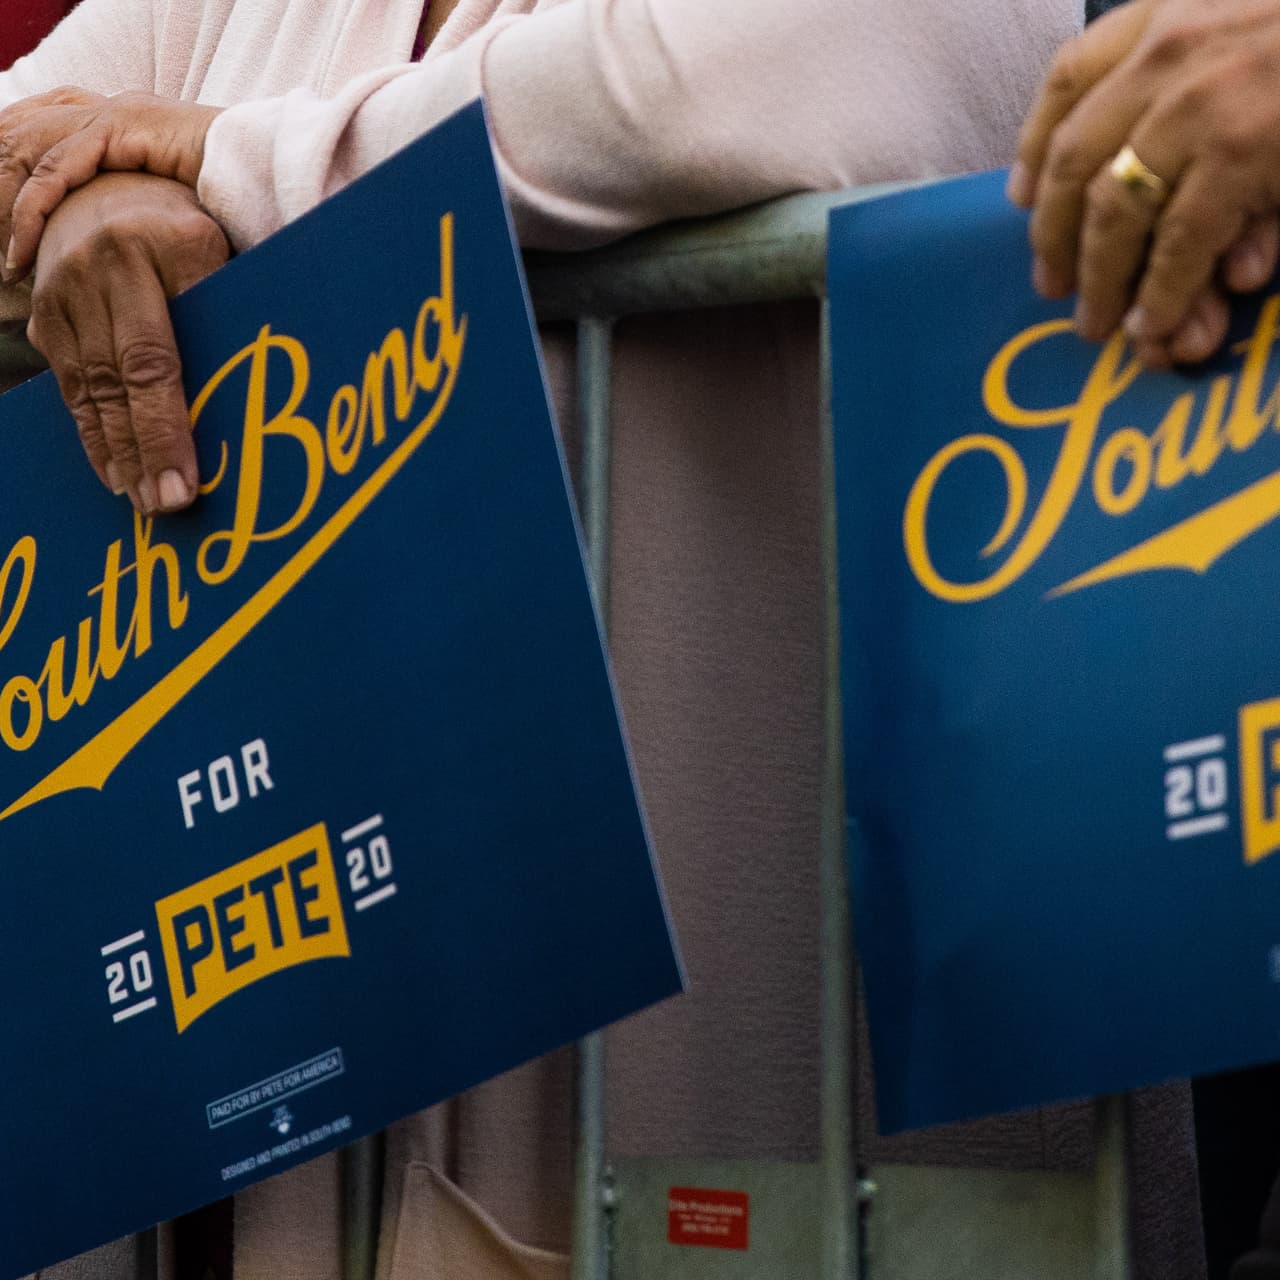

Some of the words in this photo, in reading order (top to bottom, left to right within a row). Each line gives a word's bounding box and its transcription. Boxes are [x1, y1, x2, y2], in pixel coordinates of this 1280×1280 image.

[190, 211, 468, 586] Bend
[177, 737, 274, 829] FOR
[1164, 758, 1228, 819] 20
[105, 949, 153, 1004] 20
[171, 848, 331, 1000] PETE
[346, 834, 392, 892] 20
[212, 1102, 232, 1119] PAID
[232, 1094, 250, 1111] FOR
[250, 1089, 261, 1104] BY
[262, 1080, 284, 1099] PETE
[283, 1073, 300, 1089] FOR
[301, 1054, 338, 1080] AMERICA
